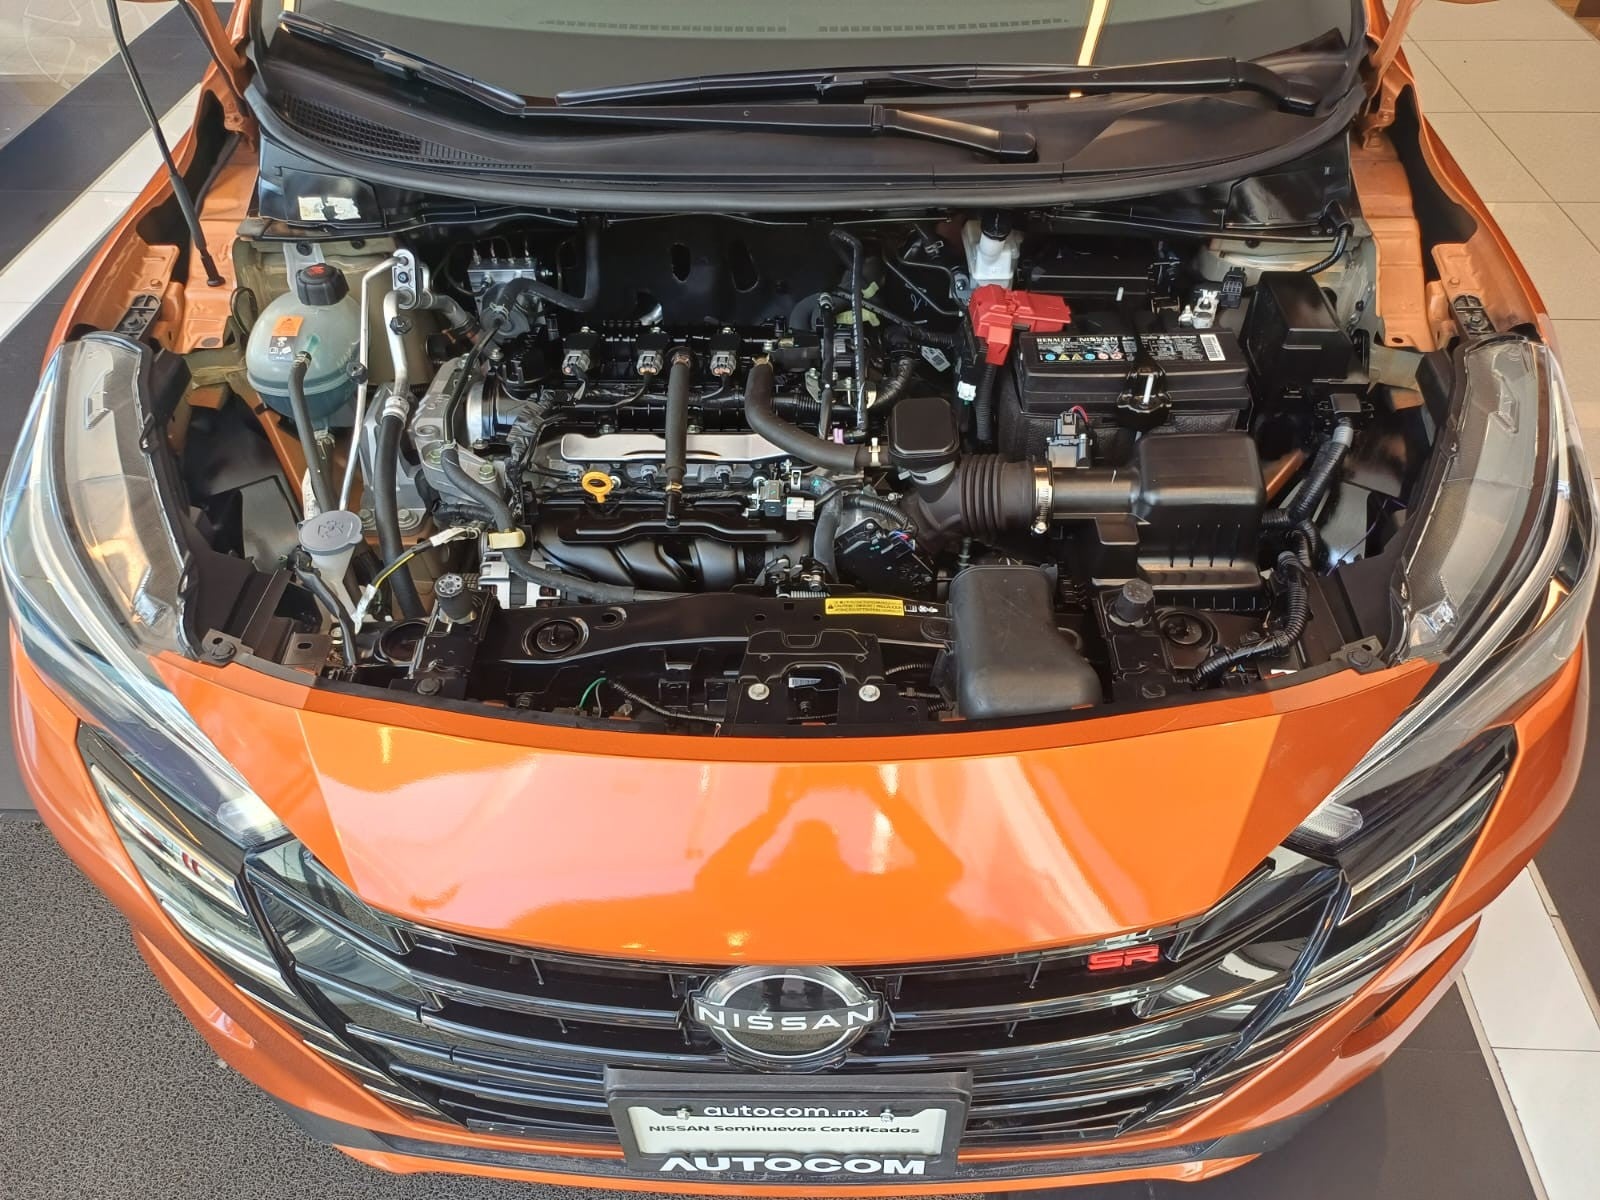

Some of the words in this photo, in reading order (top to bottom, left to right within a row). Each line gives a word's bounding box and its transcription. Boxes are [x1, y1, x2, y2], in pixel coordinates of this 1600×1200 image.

[1087, 944, 1160, 971] SR
[699, 1006, 874, 1031] NISSAN
[703, 1105, 869, 1117] autocom.mx
[660, 1157, 925, 1175] AUTOCOM
